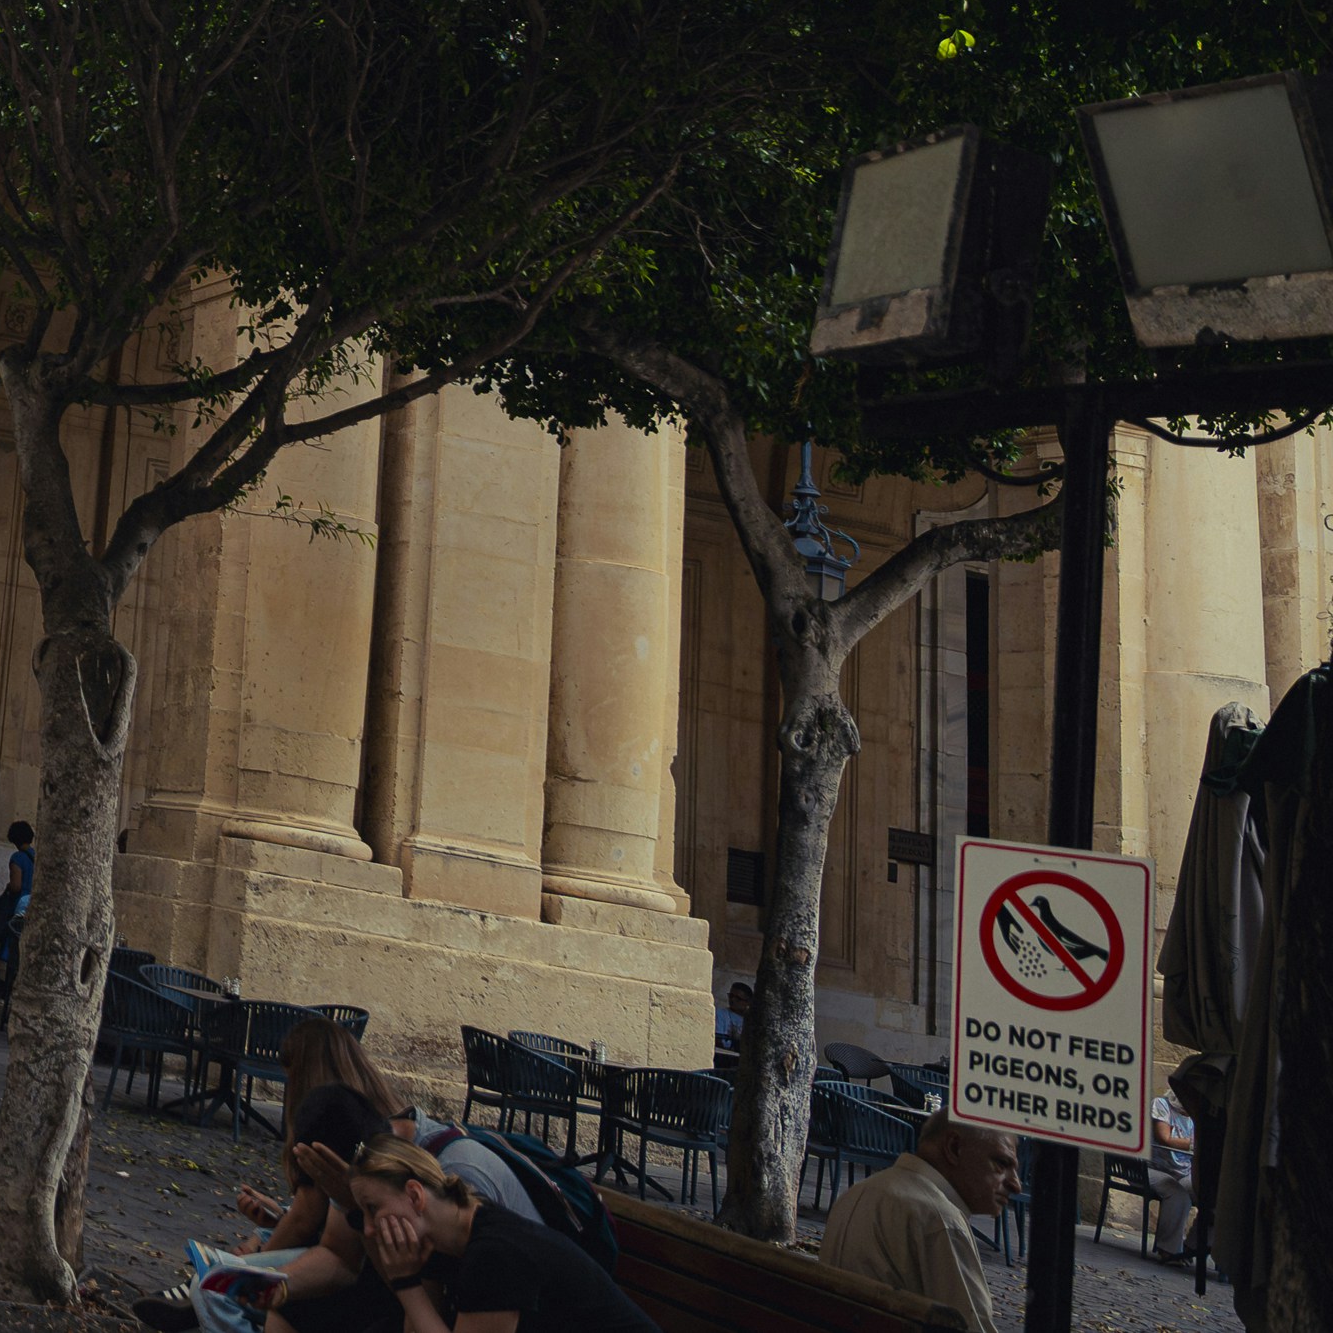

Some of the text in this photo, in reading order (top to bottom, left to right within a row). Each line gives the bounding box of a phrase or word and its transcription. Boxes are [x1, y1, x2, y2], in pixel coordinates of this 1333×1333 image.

[966, 1018, 1134, 1065] DO NOT FEED
[969, 1050, 1129, 1100] PIGEONS, OR
[965, 1083, 1132, 1133] OTHER BIRDS
